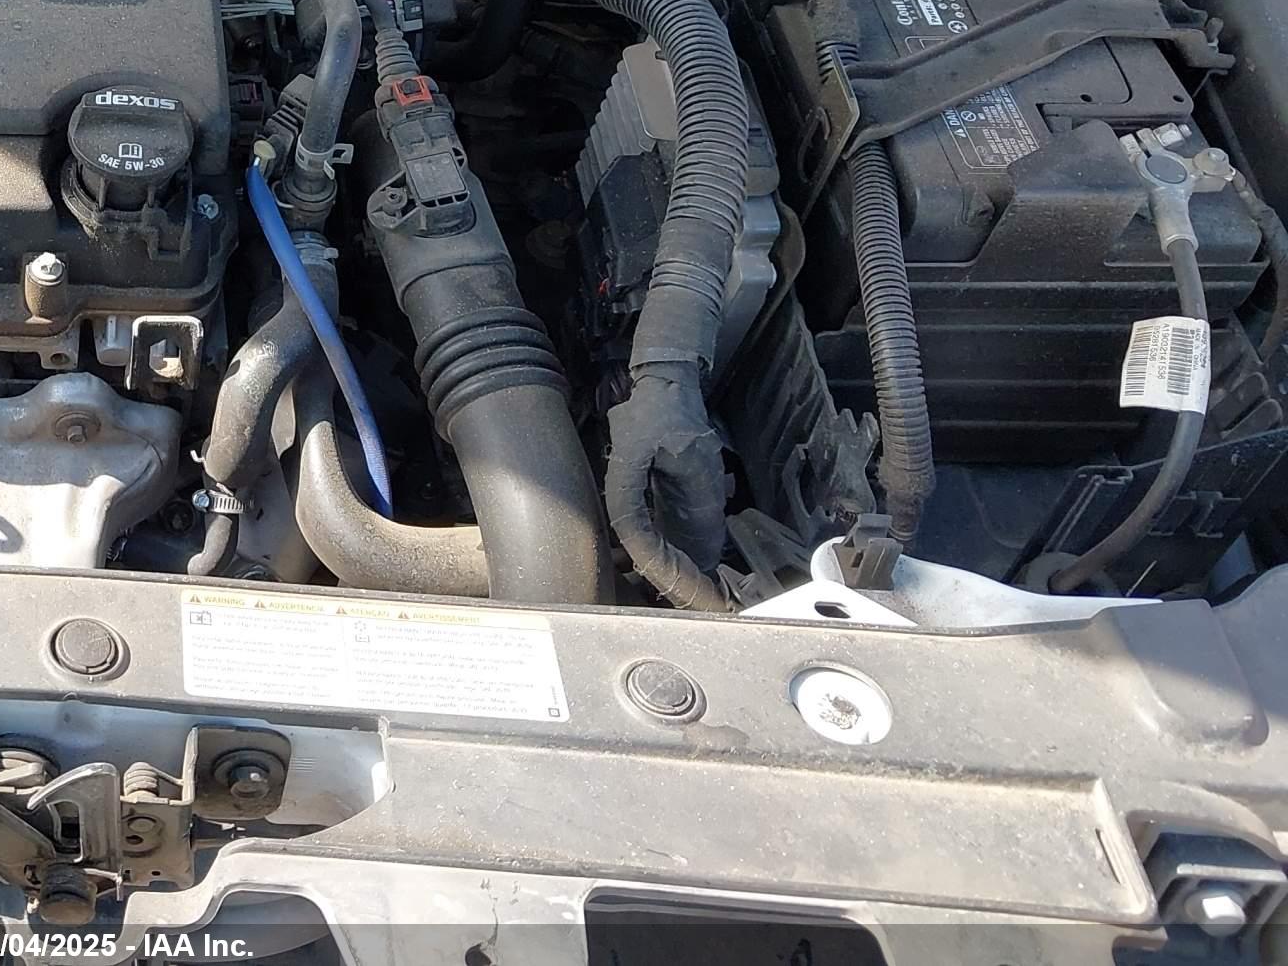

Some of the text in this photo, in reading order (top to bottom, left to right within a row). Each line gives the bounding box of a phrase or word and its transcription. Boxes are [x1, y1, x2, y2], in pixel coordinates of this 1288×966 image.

[95, 91, 179, 111] dexos
[98, 153, 165, 171] SAE 5W-30
